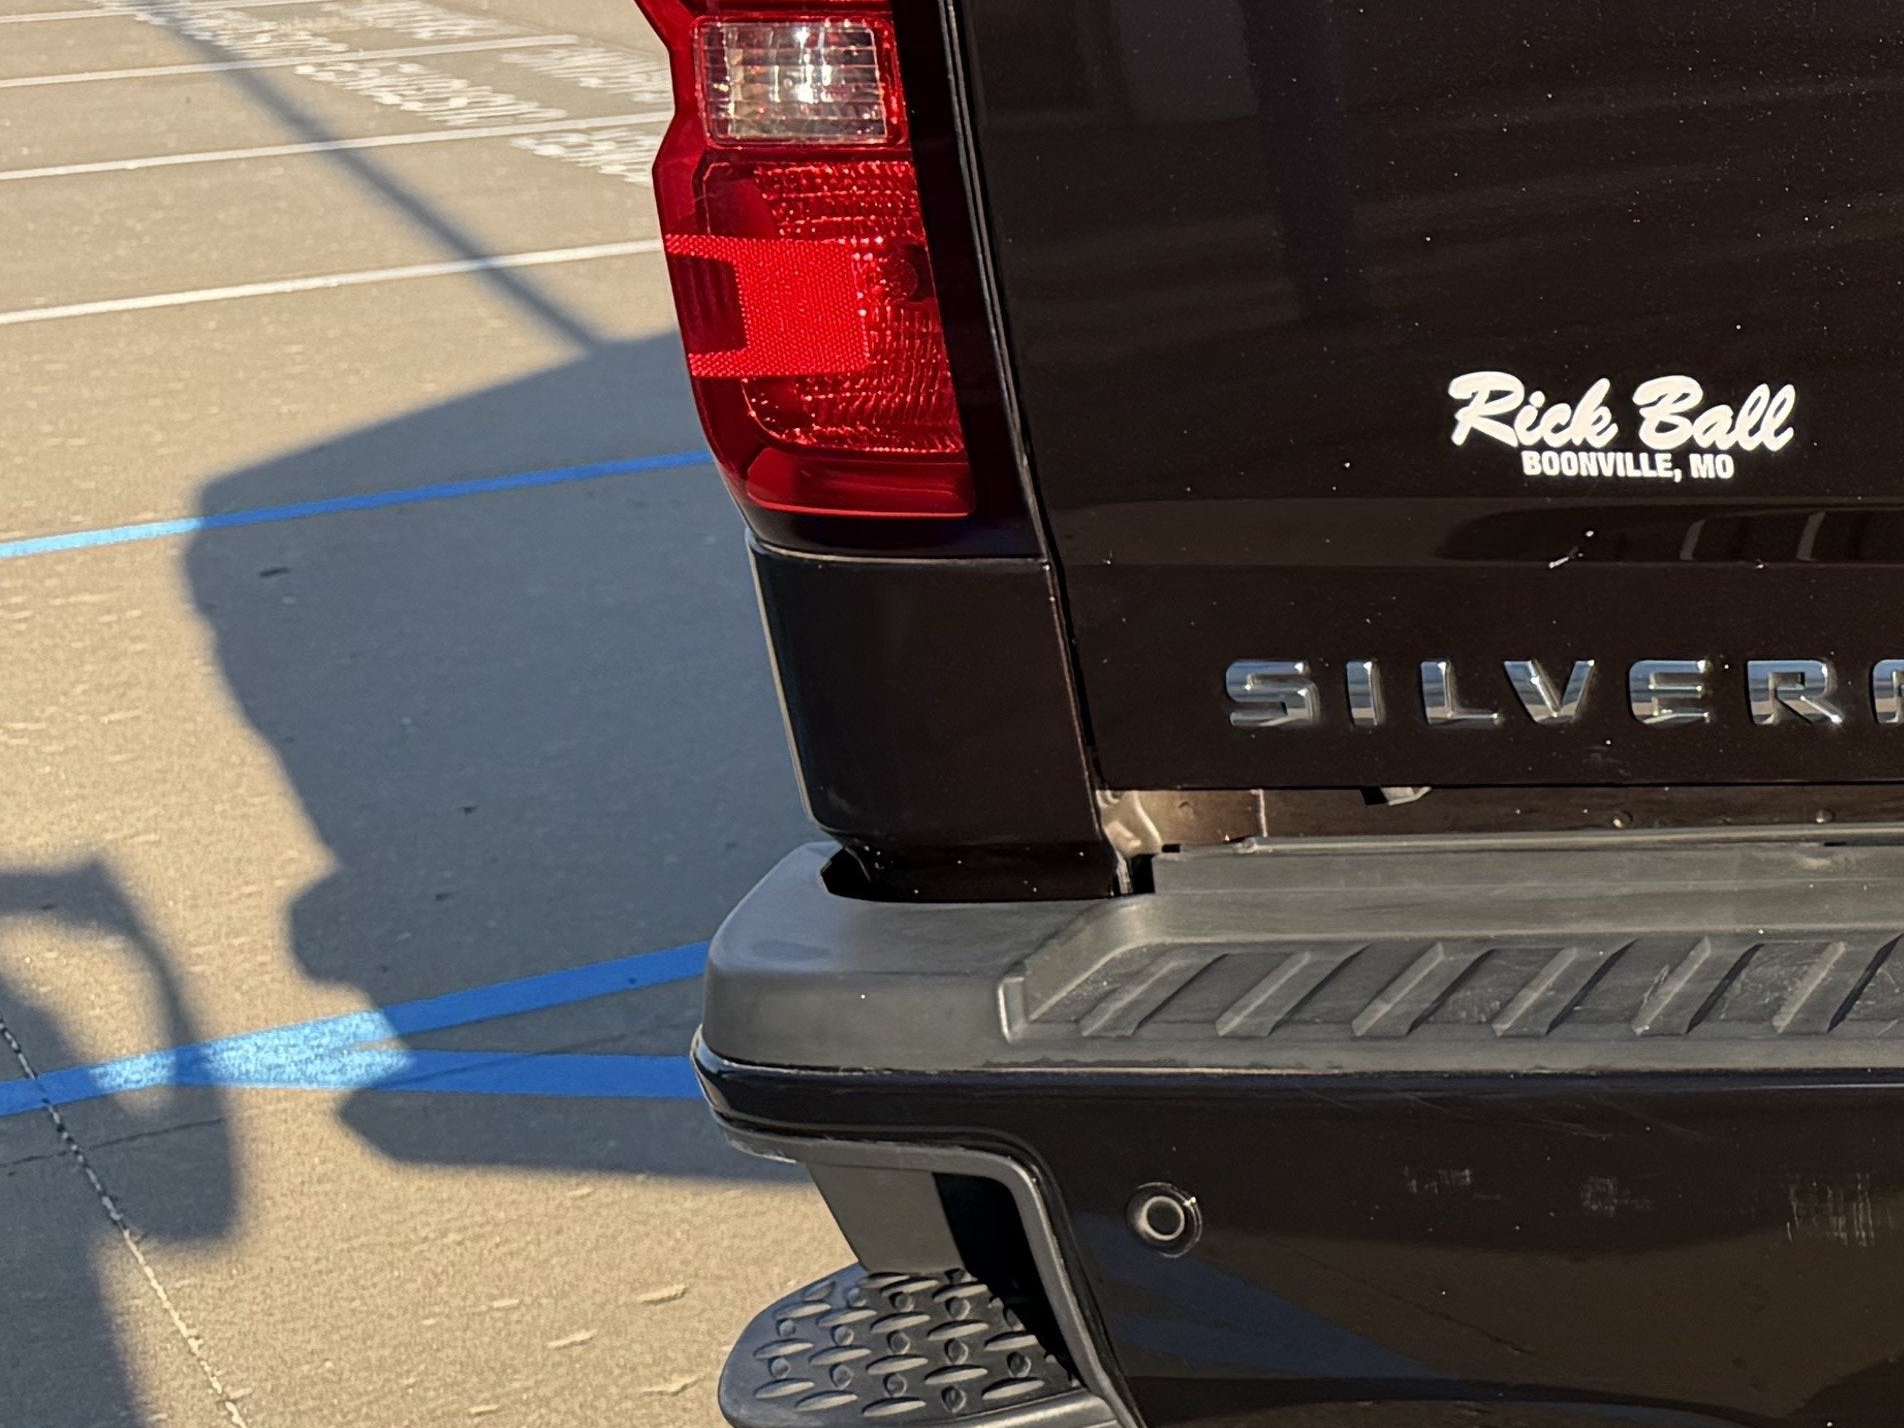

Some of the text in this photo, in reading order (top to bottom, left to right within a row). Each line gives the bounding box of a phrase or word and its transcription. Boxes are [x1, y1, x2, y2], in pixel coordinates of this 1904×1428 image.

[1447, 370, 1797, 452] Rick Ball
[1520, 450, 1735, 483] BOONVILLE, MO
